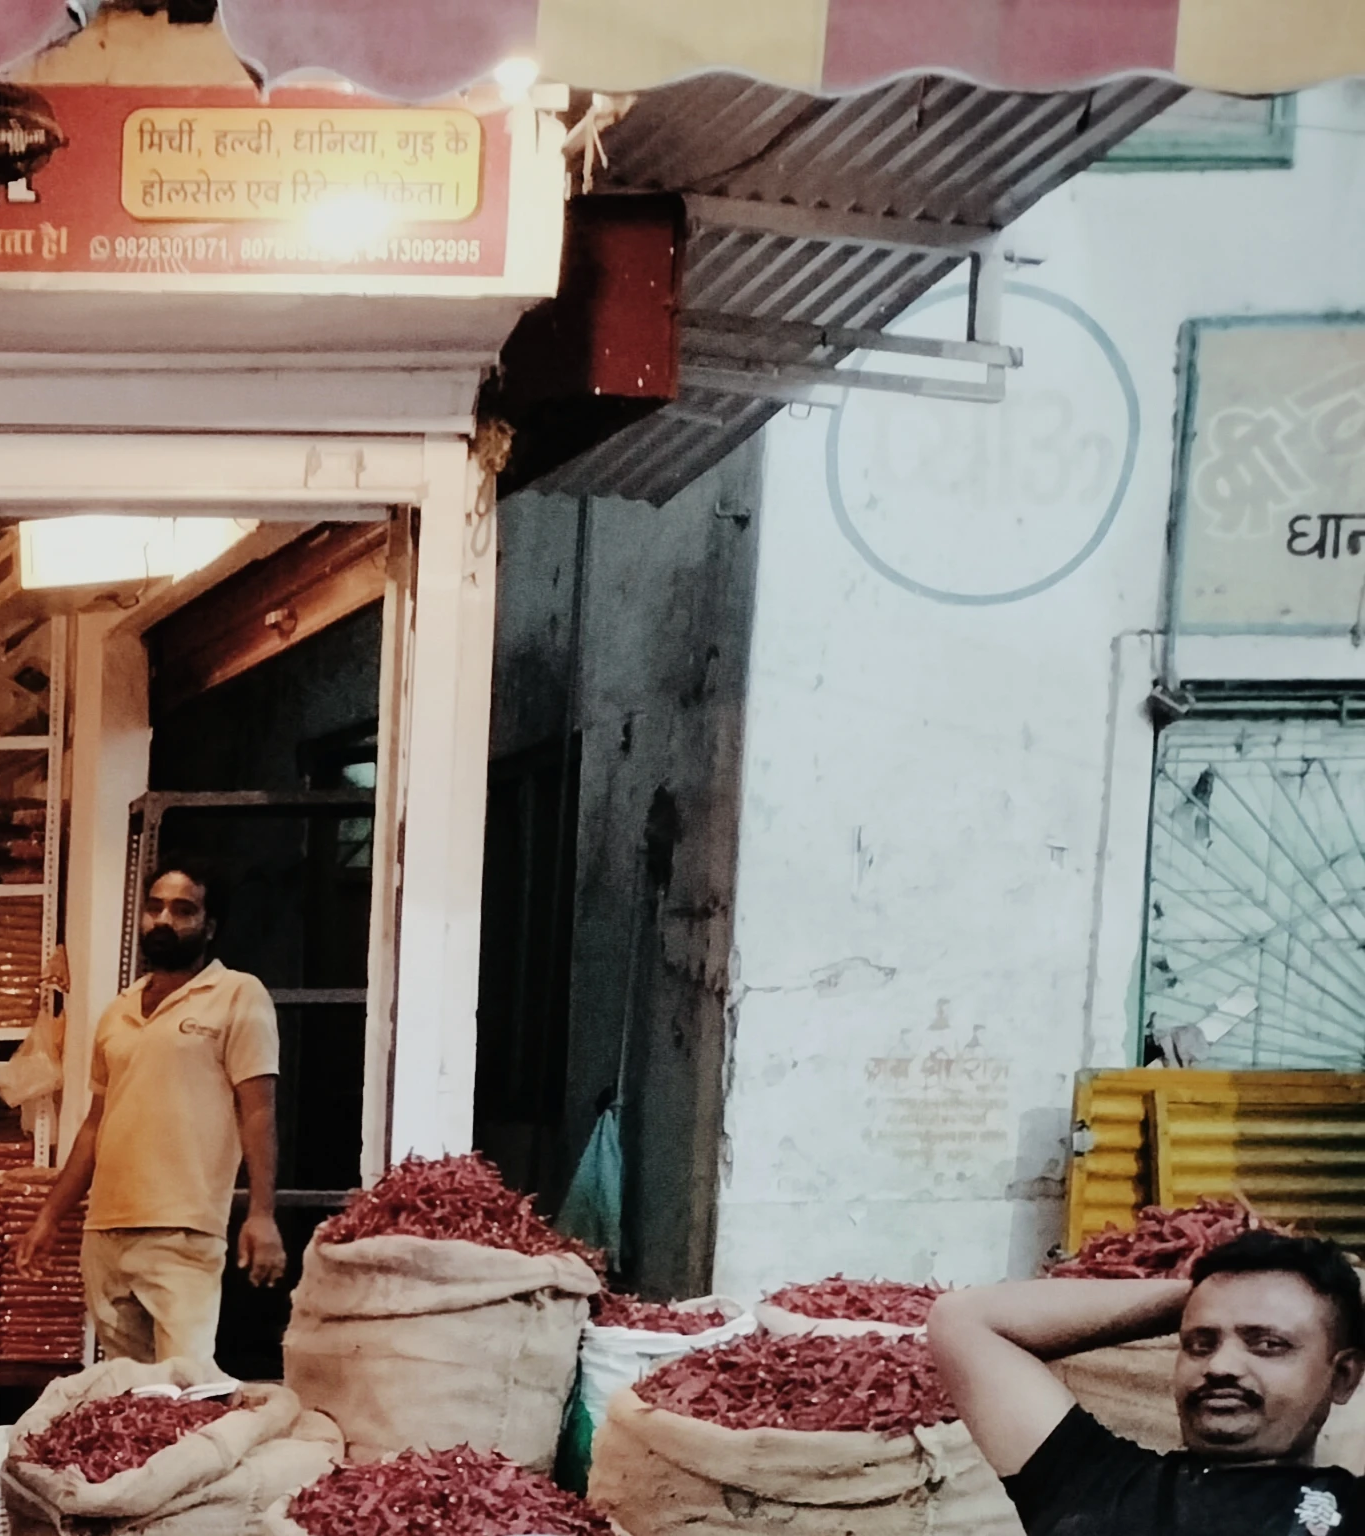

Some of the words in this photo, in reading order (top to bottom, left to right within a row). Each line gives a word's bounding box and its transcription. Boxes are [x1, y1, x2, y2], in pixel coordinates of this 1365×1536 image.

[212, 118, 281, 158] हल्दी,
[293, 119, 385, 158] धनिया,
[444, 120, 471, 156] के
[139, 168, 237, 208] होलसेल
[245, 170, 282, 209] एवं
[114, 236, 232, 266] 9828301971,
[366, 238, 480, 264] 413092995
